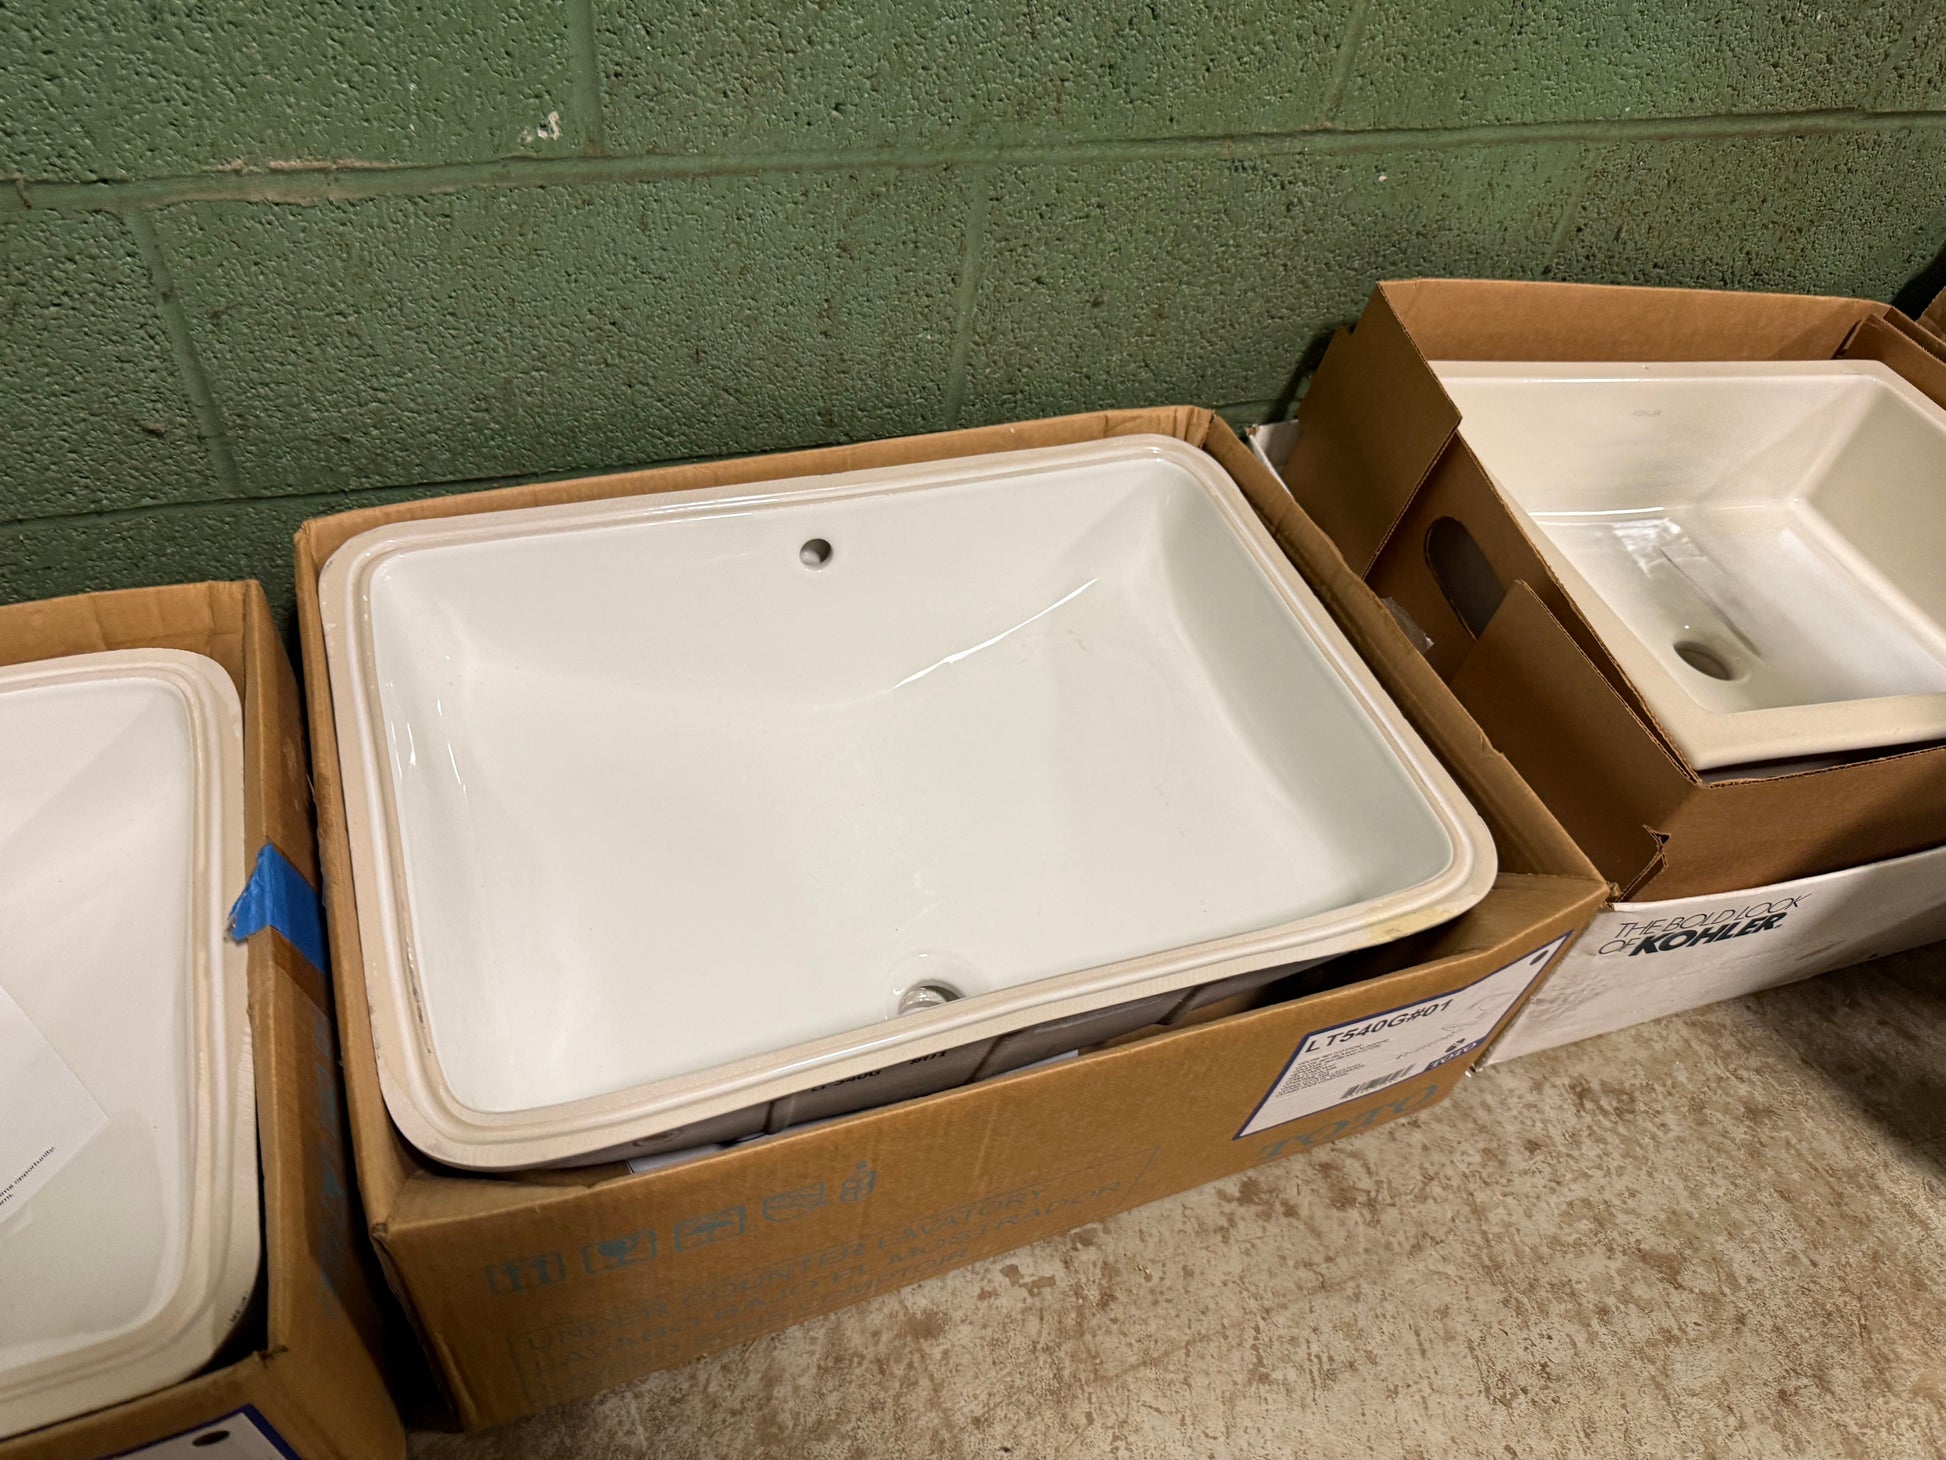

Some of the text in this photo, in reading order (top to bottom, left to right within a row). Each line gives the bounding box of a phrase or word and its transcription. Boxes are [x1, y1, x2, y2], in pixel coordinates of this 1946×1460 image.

[1614, 893, 1813, 939] THE BOLD LOOK
[1598, 937, 1636, 955] OF
[1304, 998, 1454, 1053] LT540G#01
[682, 1241, 867, 1308] COUNTER
[876, 1187, 1046, 1251] LAVATORY
